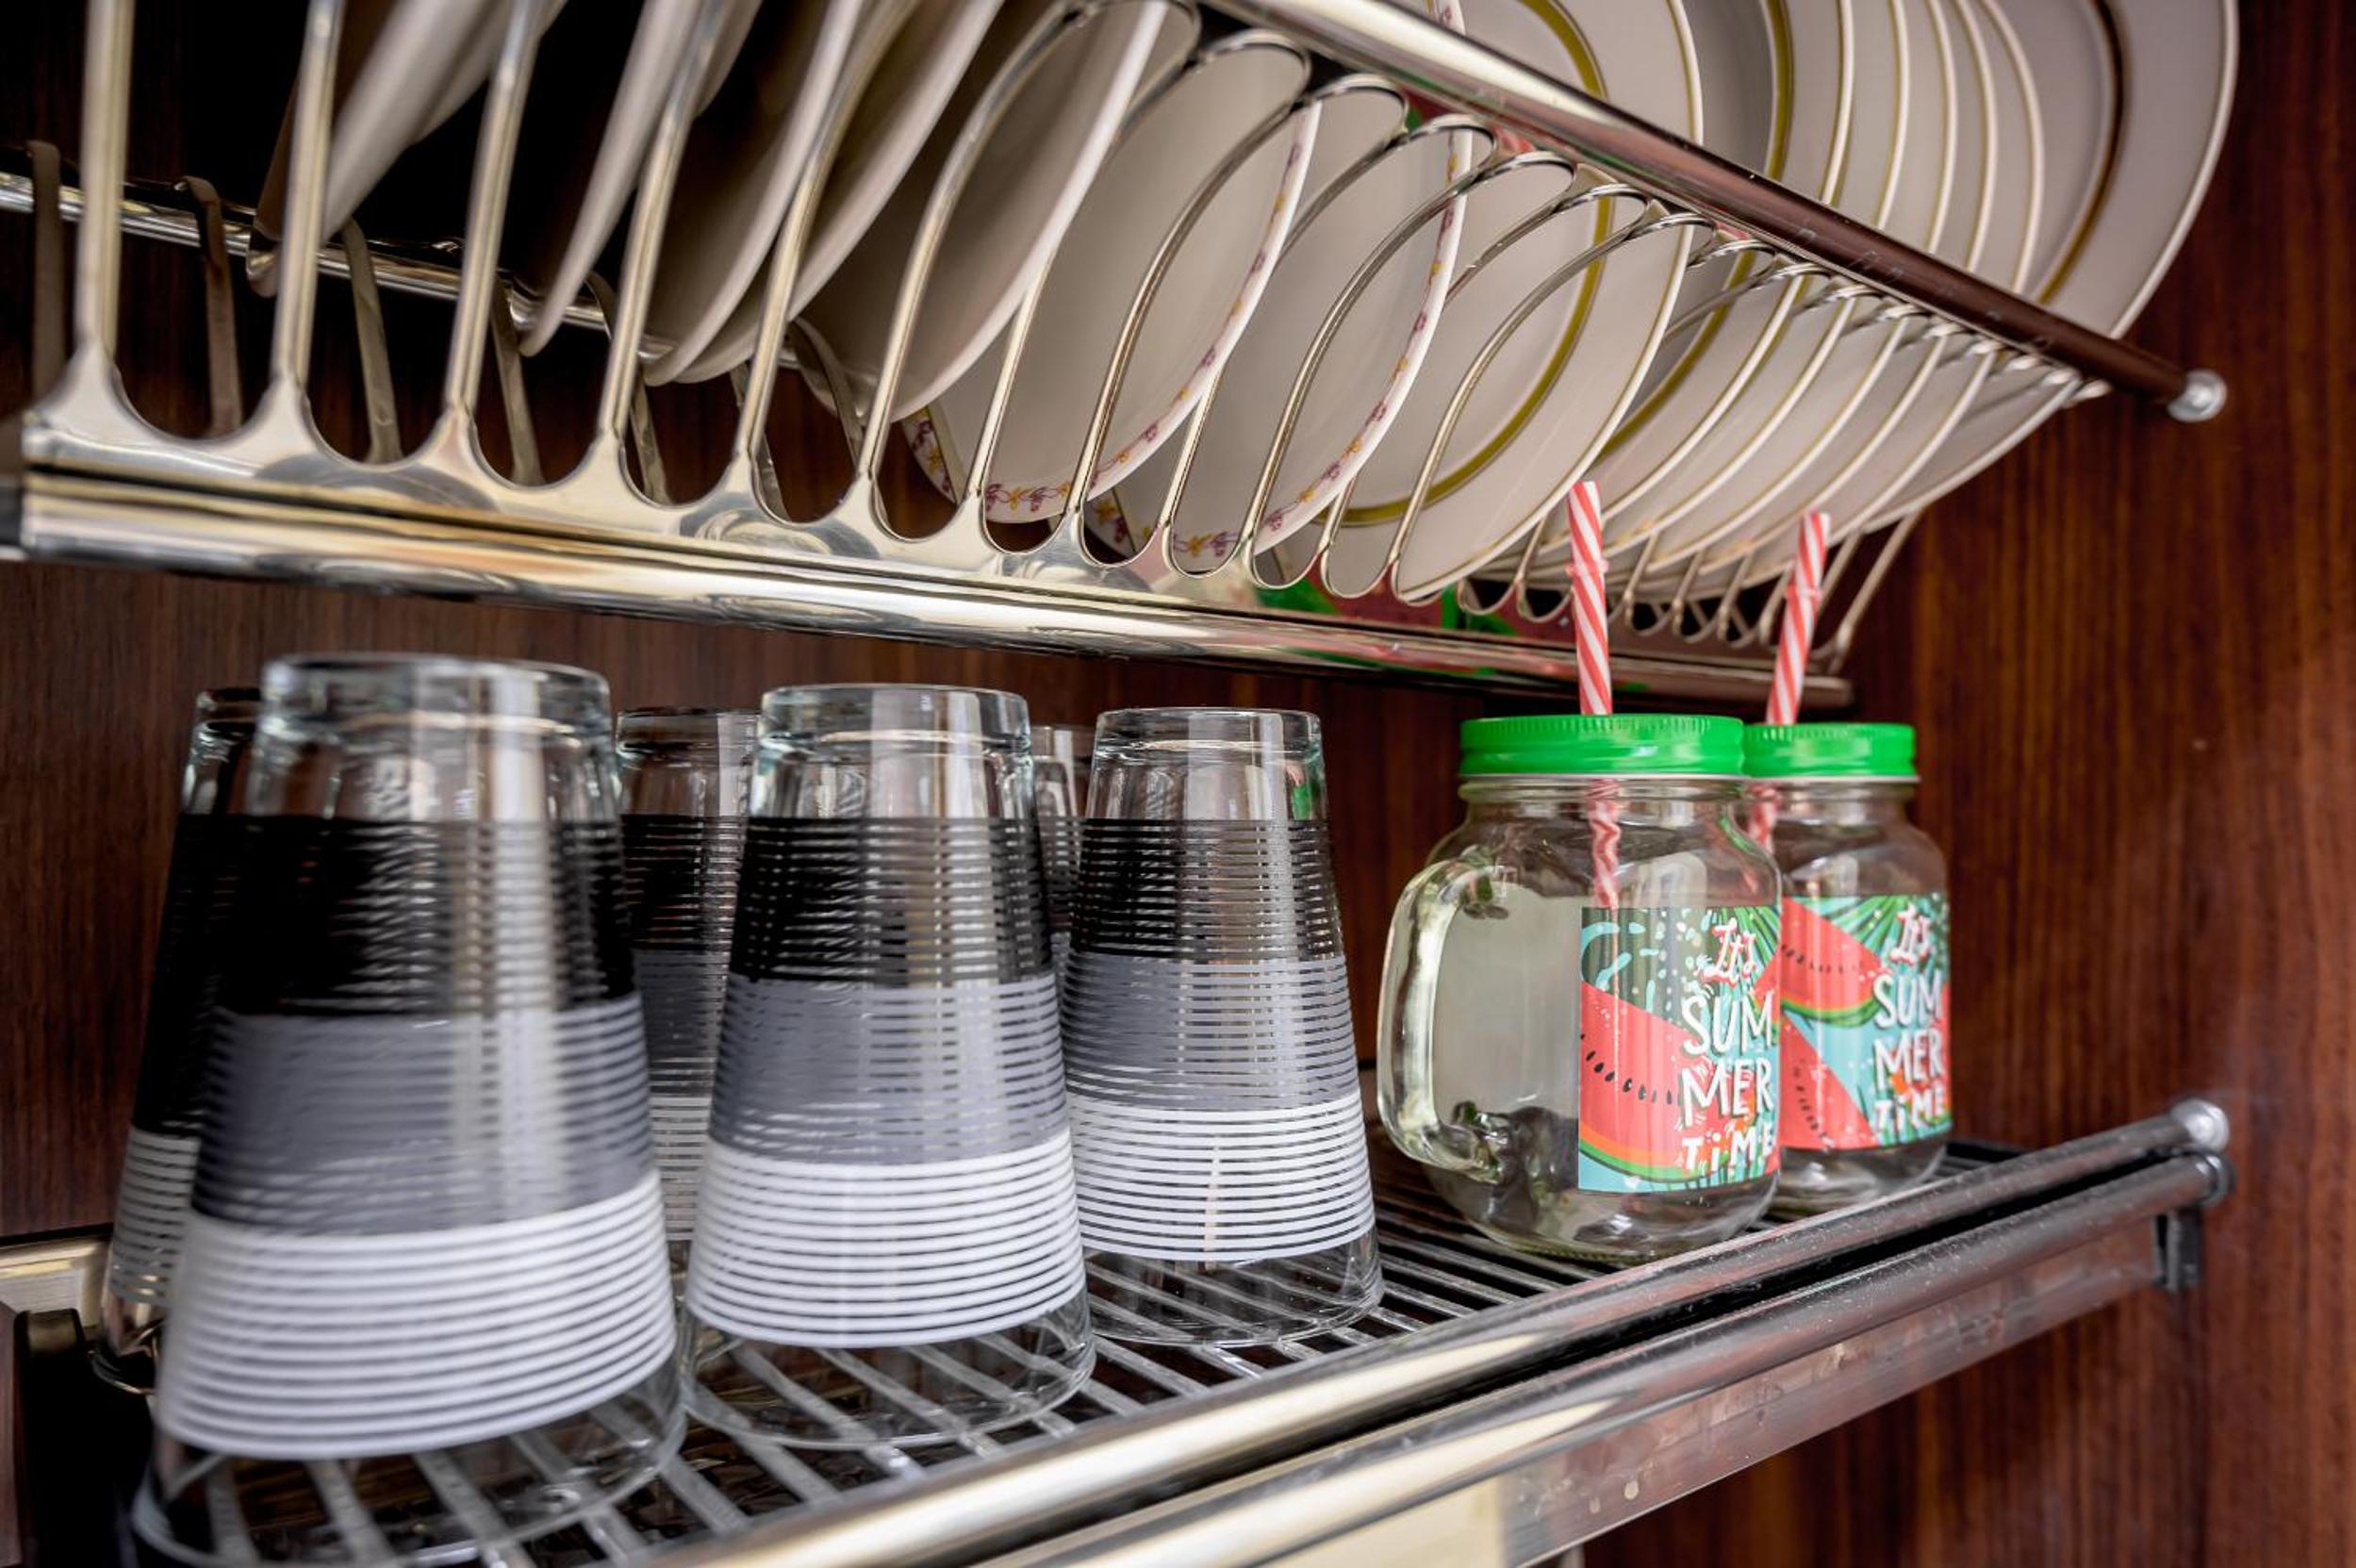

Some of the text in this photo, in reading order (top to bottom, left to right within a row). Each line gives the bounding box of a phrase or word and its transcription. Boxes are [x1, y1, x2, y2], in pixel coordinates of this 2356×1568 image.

[1683, 989, 1775, 1055] SUM
[1873, 969, 1943, 1029] SUM
[1873, 1029, 1943, 1090] MER
[1682, 1058, 1775, 1129] MER
